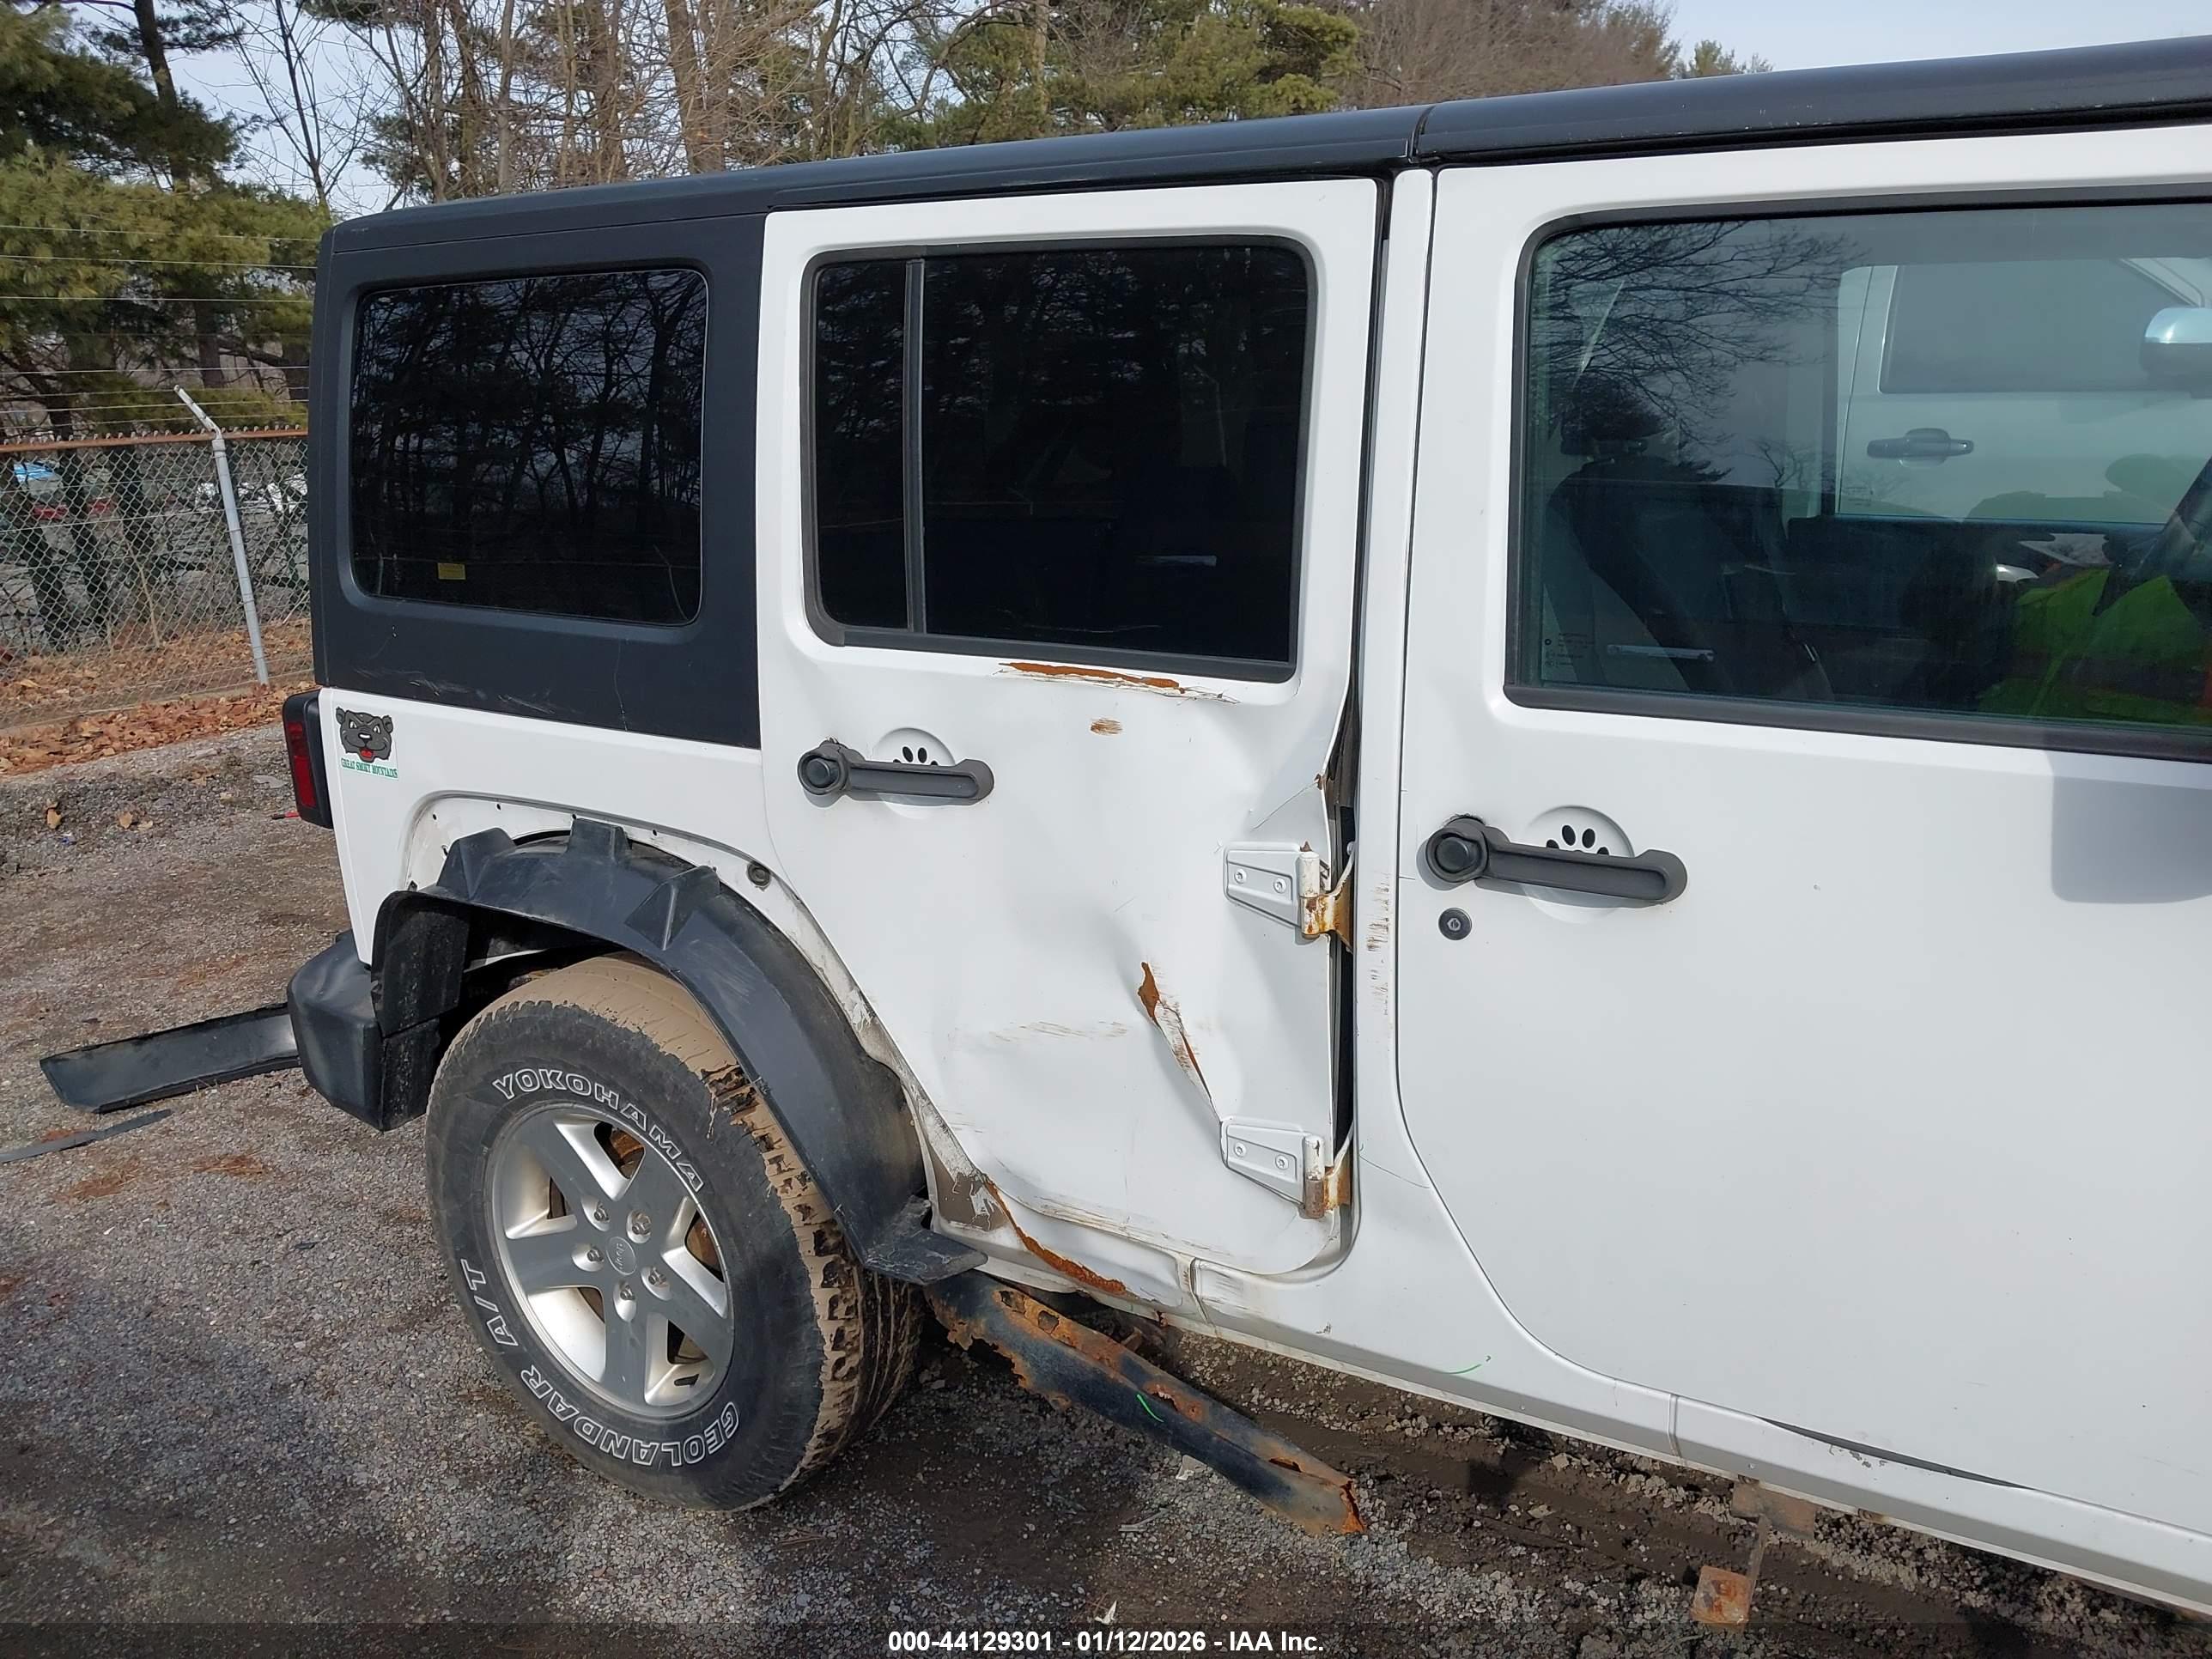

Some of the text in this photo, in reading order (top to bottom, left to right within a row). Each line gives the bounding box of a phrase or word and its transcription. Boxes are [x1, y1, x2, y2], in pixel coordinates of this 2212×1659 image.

[492, 1068, 704, 1192] YOKOHAMA
[460, 1259, 739, 1466] GEOLANDAR A/T
